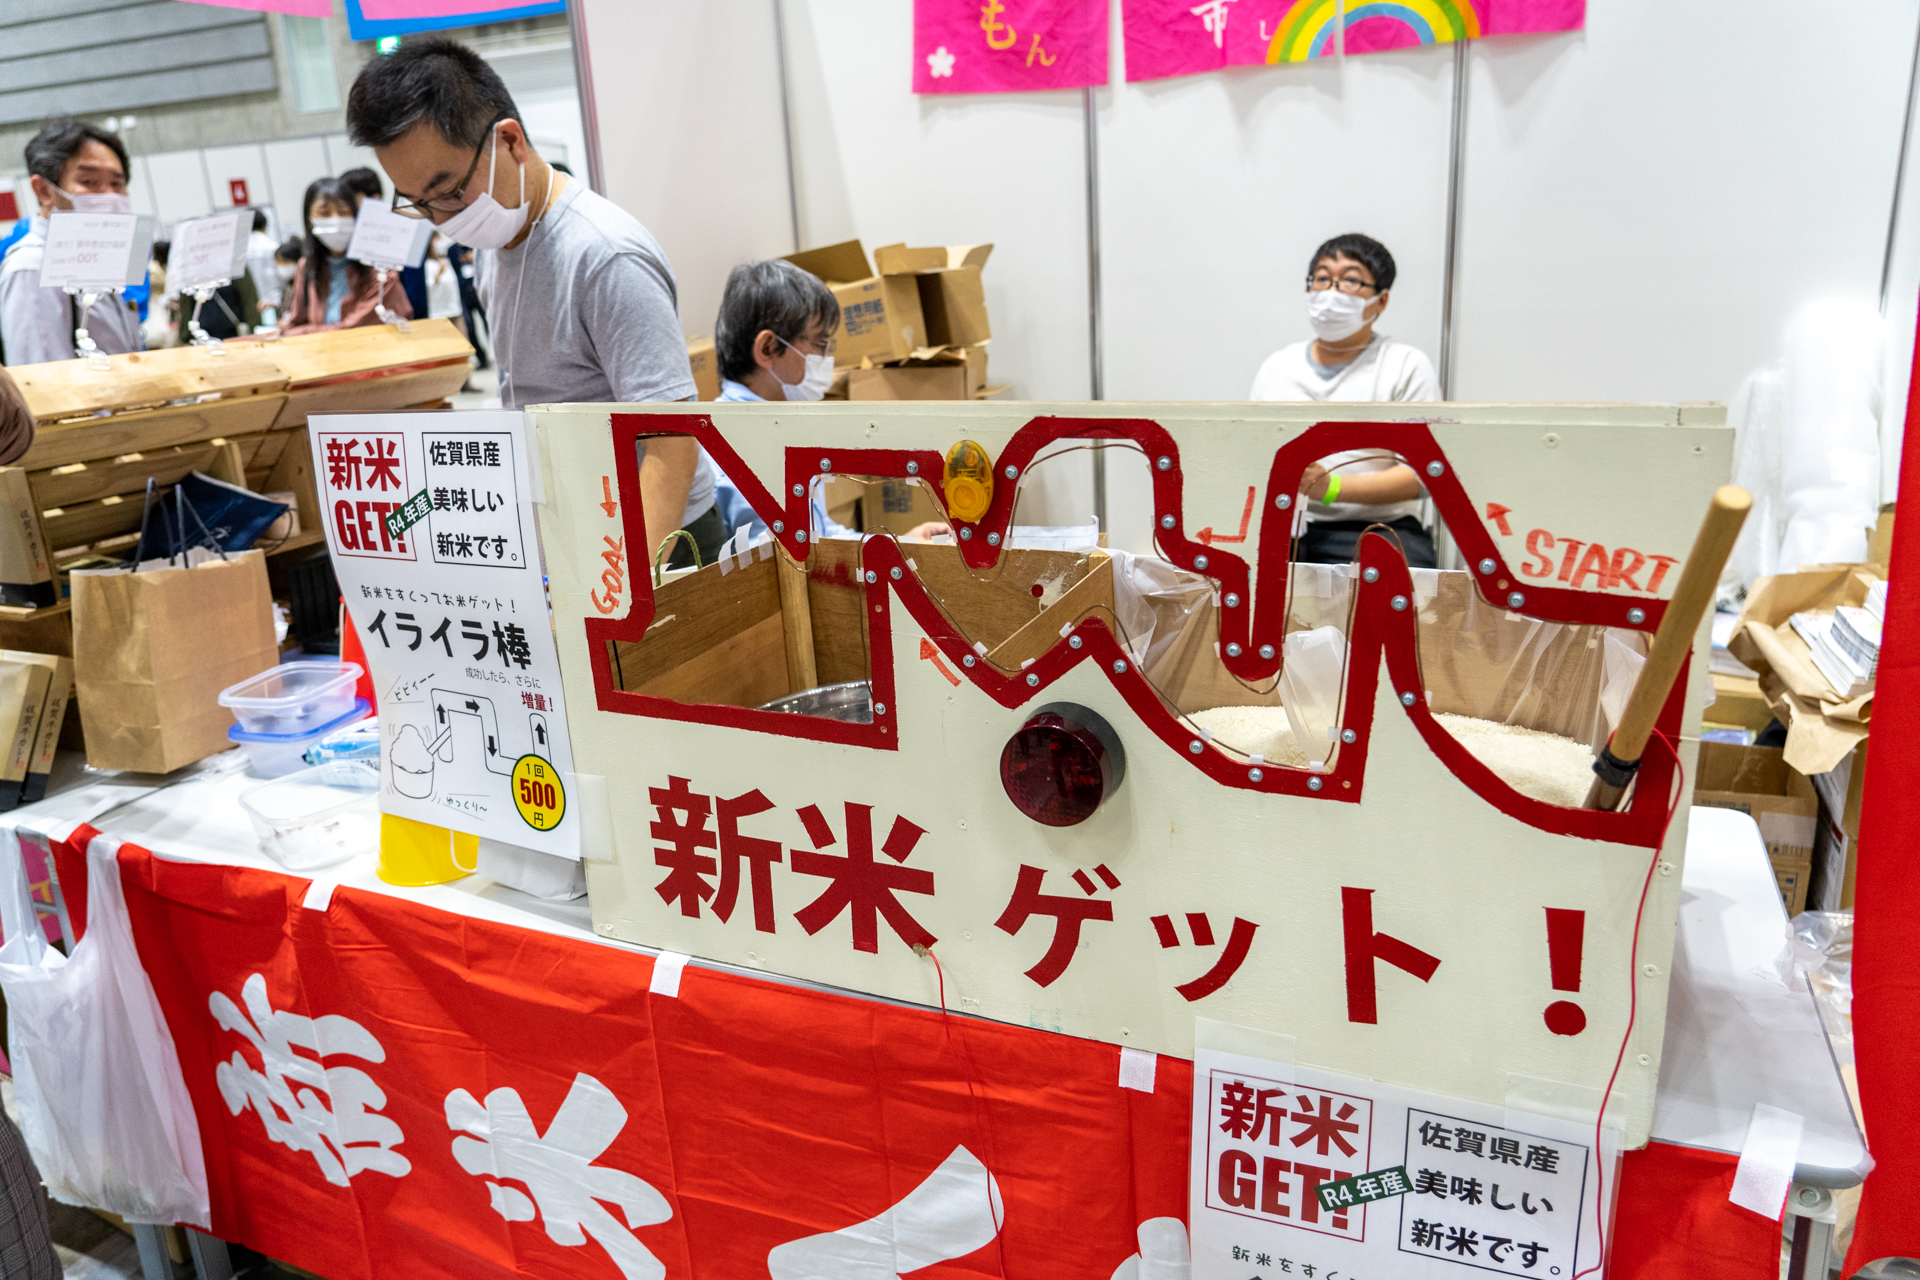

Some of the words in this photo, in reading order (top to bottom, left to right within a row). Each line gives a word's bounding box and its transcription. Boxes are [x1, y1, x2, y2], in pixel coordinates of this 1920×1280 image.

[326, 437, 402, 492] 新米
[429, 440, 501, 467] 佐賀県産
[433, 487, 504, 513] 美味しい
[334, 499, 408, 554] GET!
[436, 531, 518, 561] 新米です。
[590, 534, 625, 615] GOAL
[1521, 528, 1681, 594] START
[367, 608, 532, 671] イライラ棒
[465, 667, 542, 689] 成功したら、さらに
[519, 777, 557, 811] 500
[525, 763, 545, 780] 1回
[533, 812, 544, 828] 円
[1219, 1078, 1360, 1158] 新米
[1418, 1119, 1561, 1175] 佐賀県産
[1217, 1148, 1354, 1231] GET!
[1414, 1167, 1555, 1216] 美味しい
[1232, 1245, 1355, 1280] 新米をすく
[1410, 1217, 1562, 1276] 新米です。
